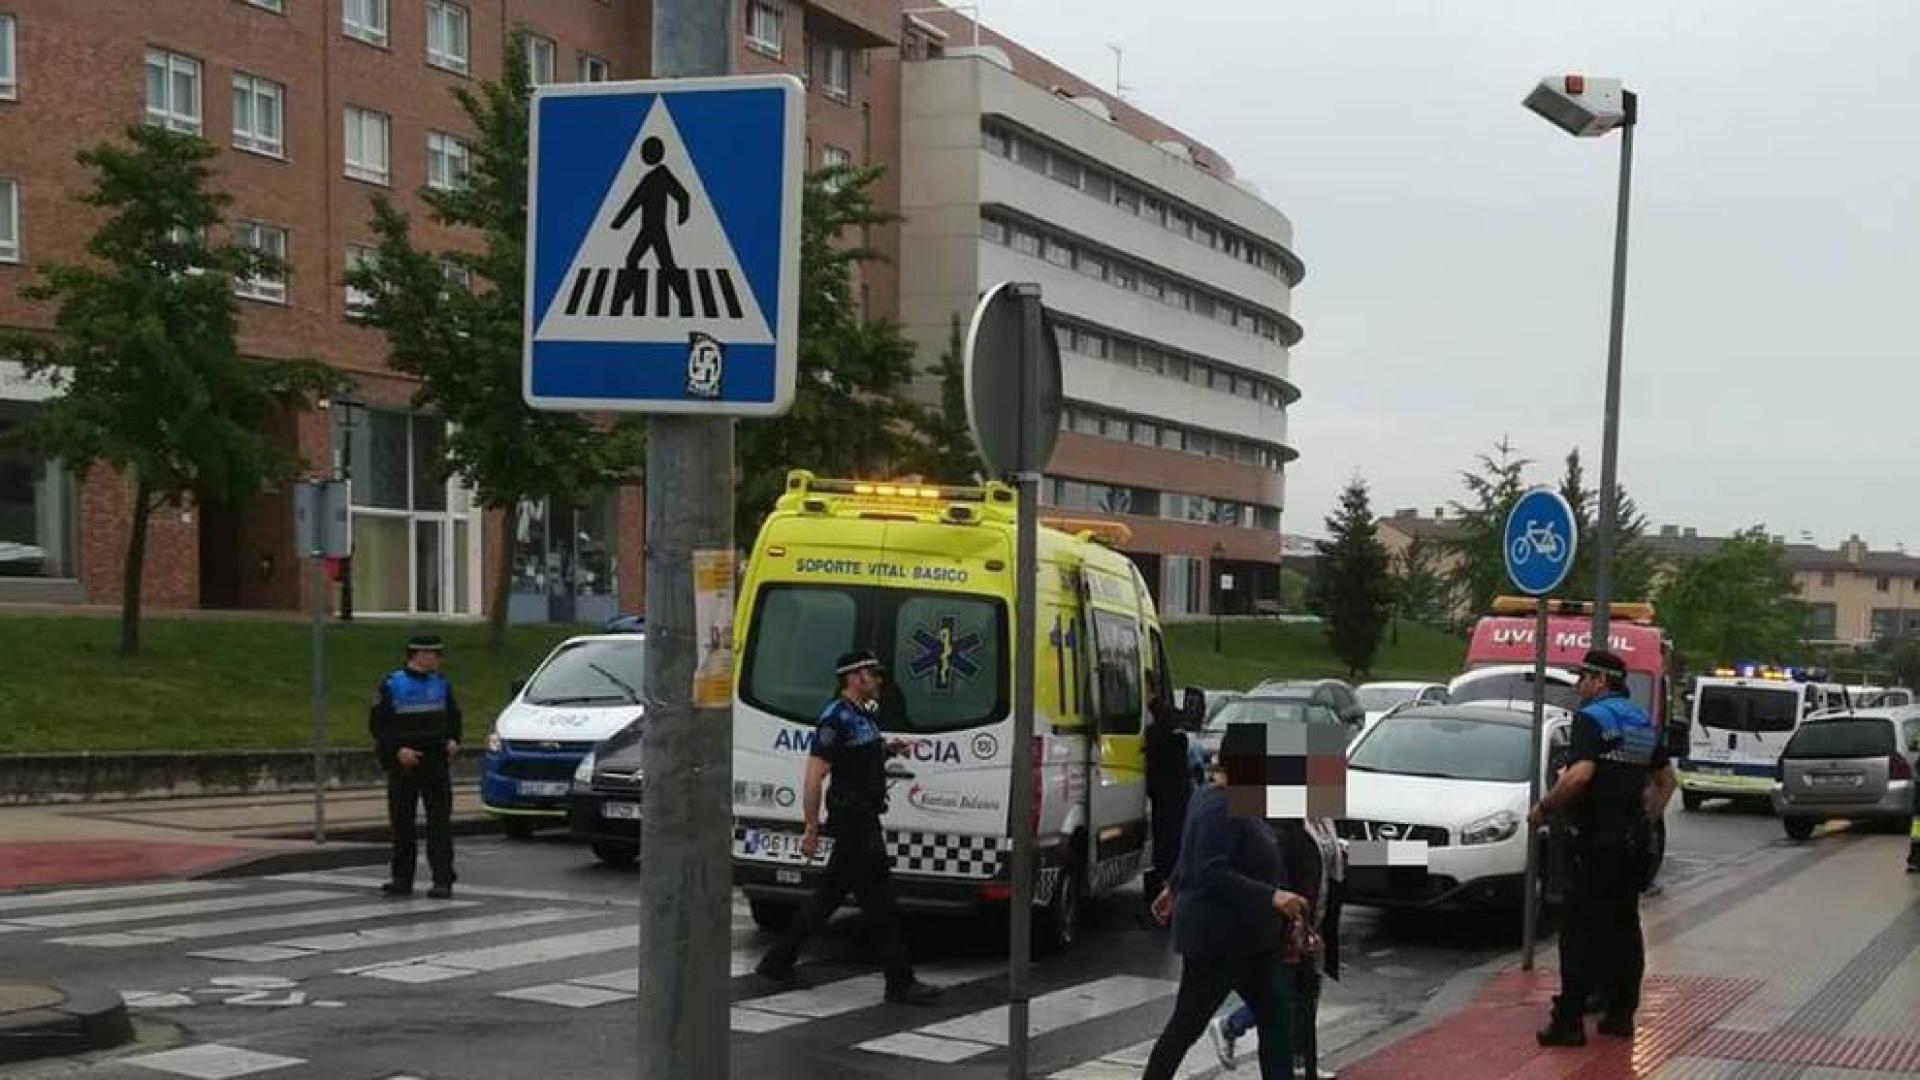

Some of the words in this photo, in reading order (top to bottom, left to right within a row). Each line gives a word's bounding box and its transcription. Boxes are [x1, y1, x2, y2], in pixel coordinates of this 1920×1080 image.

[796, 558, 862, 575] SOPORTE
[868, 562, 906, 577] VITAL
[1493, 629, 1534, 643] UVI
